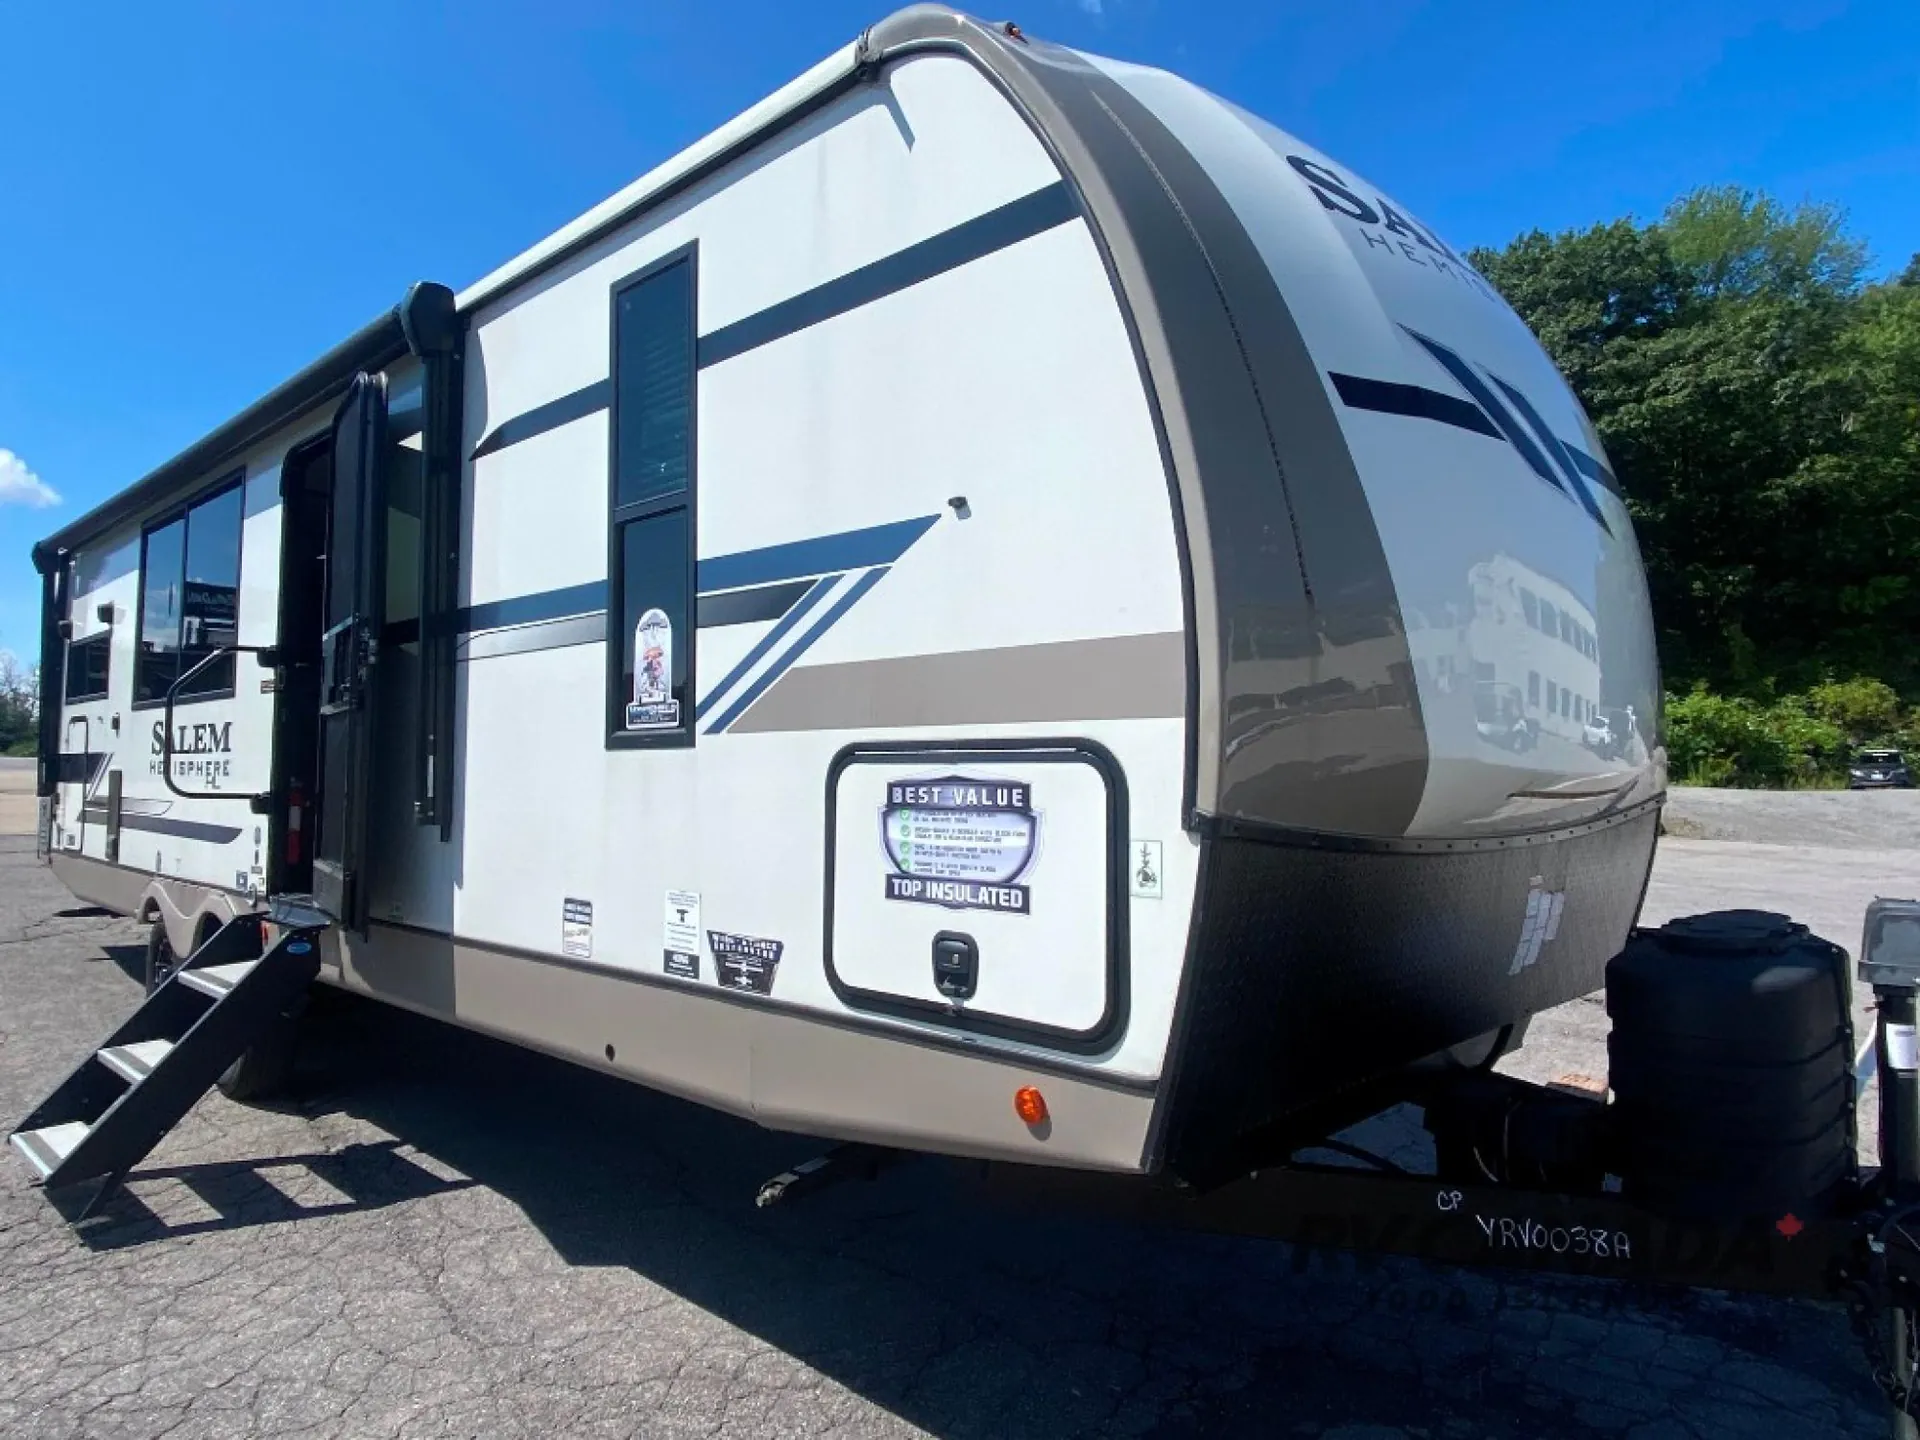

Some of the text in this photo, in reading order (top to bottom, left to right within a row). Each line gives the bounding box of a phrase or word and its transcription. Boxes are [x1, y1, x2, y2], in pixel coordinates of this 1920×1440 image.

[151, 720, 233, 756] SLEM
[149, 759, 230, 777] HEISPHERE
[892, 786, 1024, 807] BEST VALUE
[892, 878, 1023, 908] TOP INSULATED
